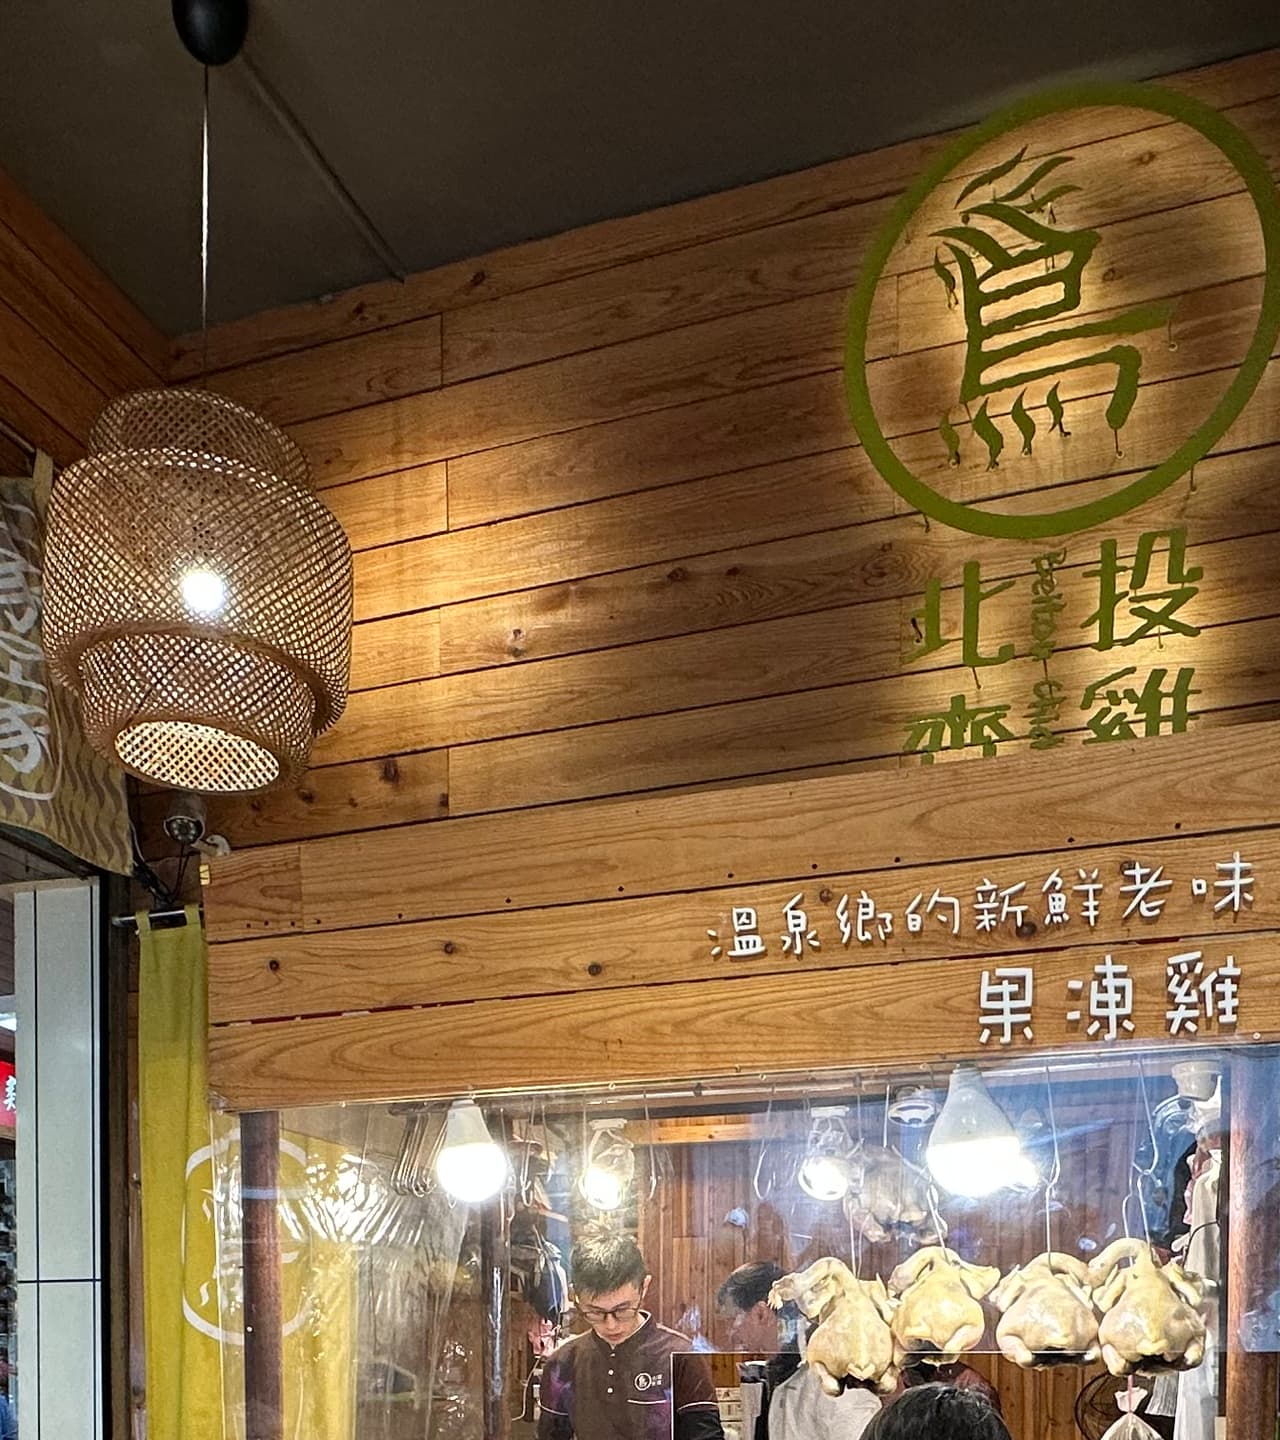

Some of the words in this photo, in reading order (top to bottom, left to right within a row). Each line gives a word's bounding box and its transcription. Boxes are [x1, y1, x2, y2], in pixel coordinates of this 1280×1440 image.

[900, 525, 1204, 668] 北投
[707, 850, 1256, 958] 溫泉鄉的新鮮老味
[978, 951, 1242, 1045] 果凍雞
